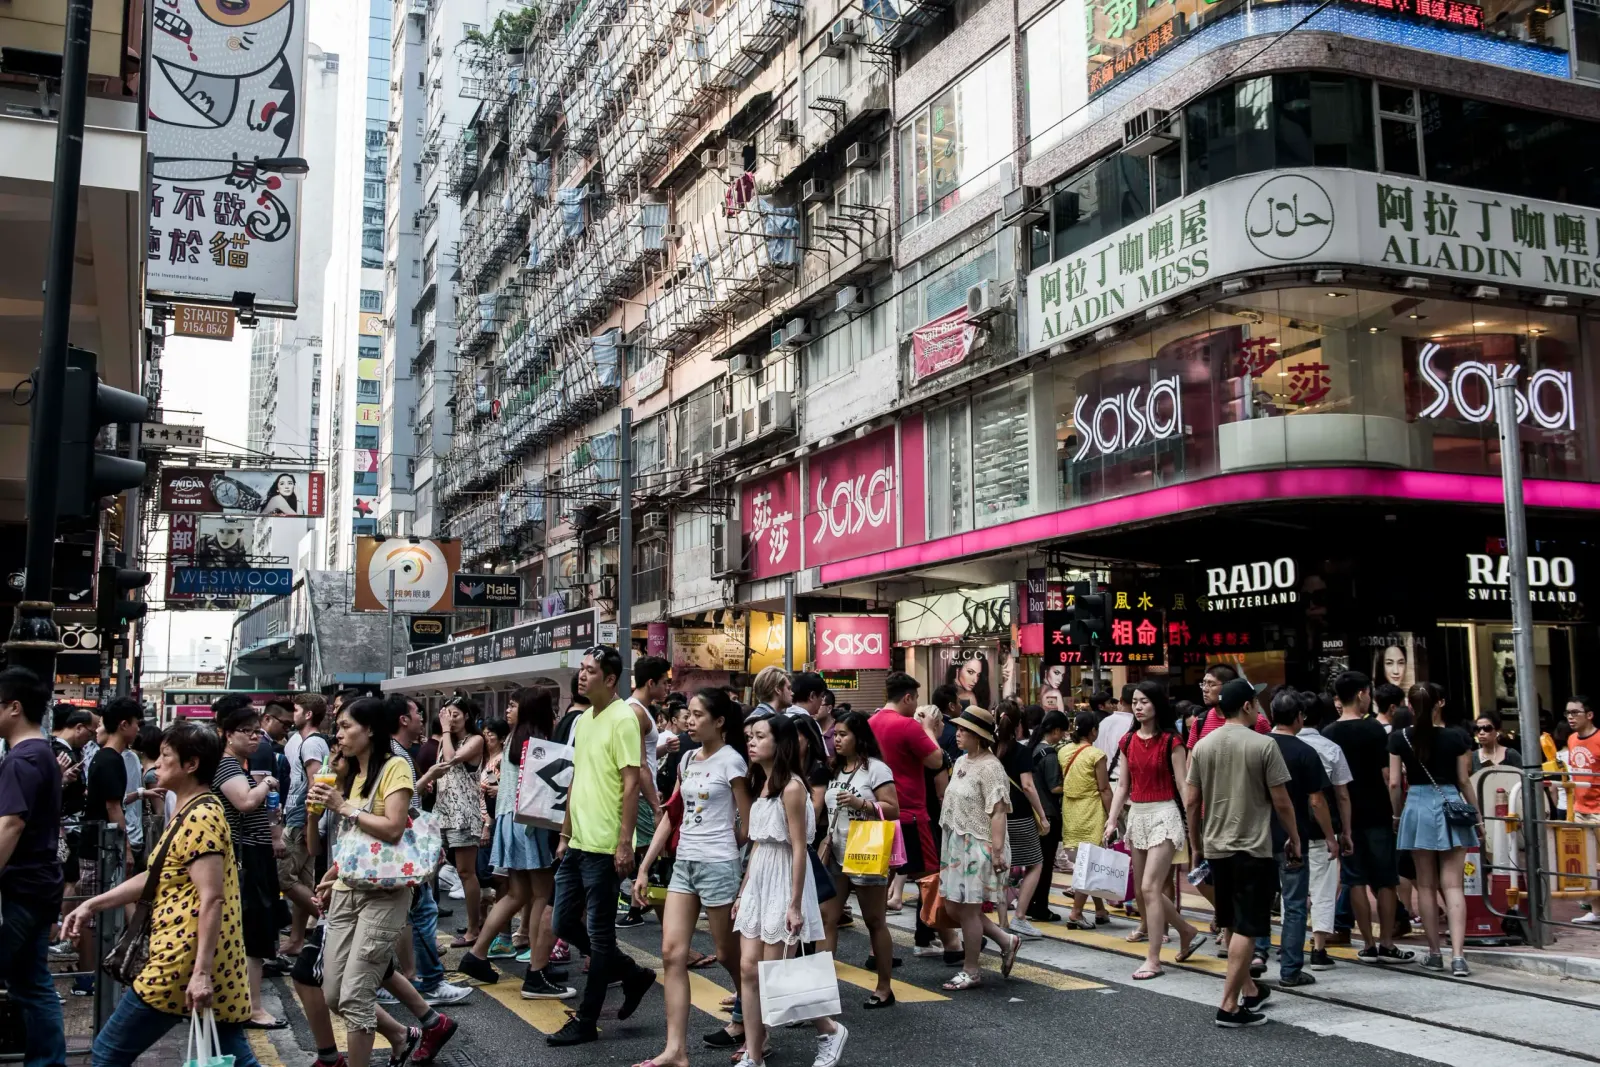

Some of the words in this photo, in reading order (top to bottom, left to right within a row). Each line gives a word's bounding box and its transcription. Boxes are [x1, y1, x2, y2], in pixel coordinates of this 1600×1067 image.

[1381, 235, 1522, 278] ALADIN
[1040, 283, 1126, 342] ALADIN
[1138, 248, 1209, 303] MESS
[183, 307, 229, 324] STRAITS
[182, 321, 204, 334] 9154
[206, 323, 228, 336] 0547
[1237, 336, 1332, 404] 莎莎
[169, 479, 205, 489] ENICAR
[749, 490, 793, 565] 莎莎
[1206, 557, 1296, 597] RADO
[486, 583, 517, 596] Nails
[1028, 579, 1045, 594] Nail
[1029, 597, 1045, 612] Box
[1114, 591, 1154, 611] 風水
[1208, 591, 1297, 611] SWITZERLAND
[1111, 618, 1157, 646] 相命
[1322, 639, 1344, 648] RADO
[940, 649, 988, 661] GUCCI
[847, 853, 871, 861] FOREVER
[1090, 861, 1125, 879] TOPSHOP
